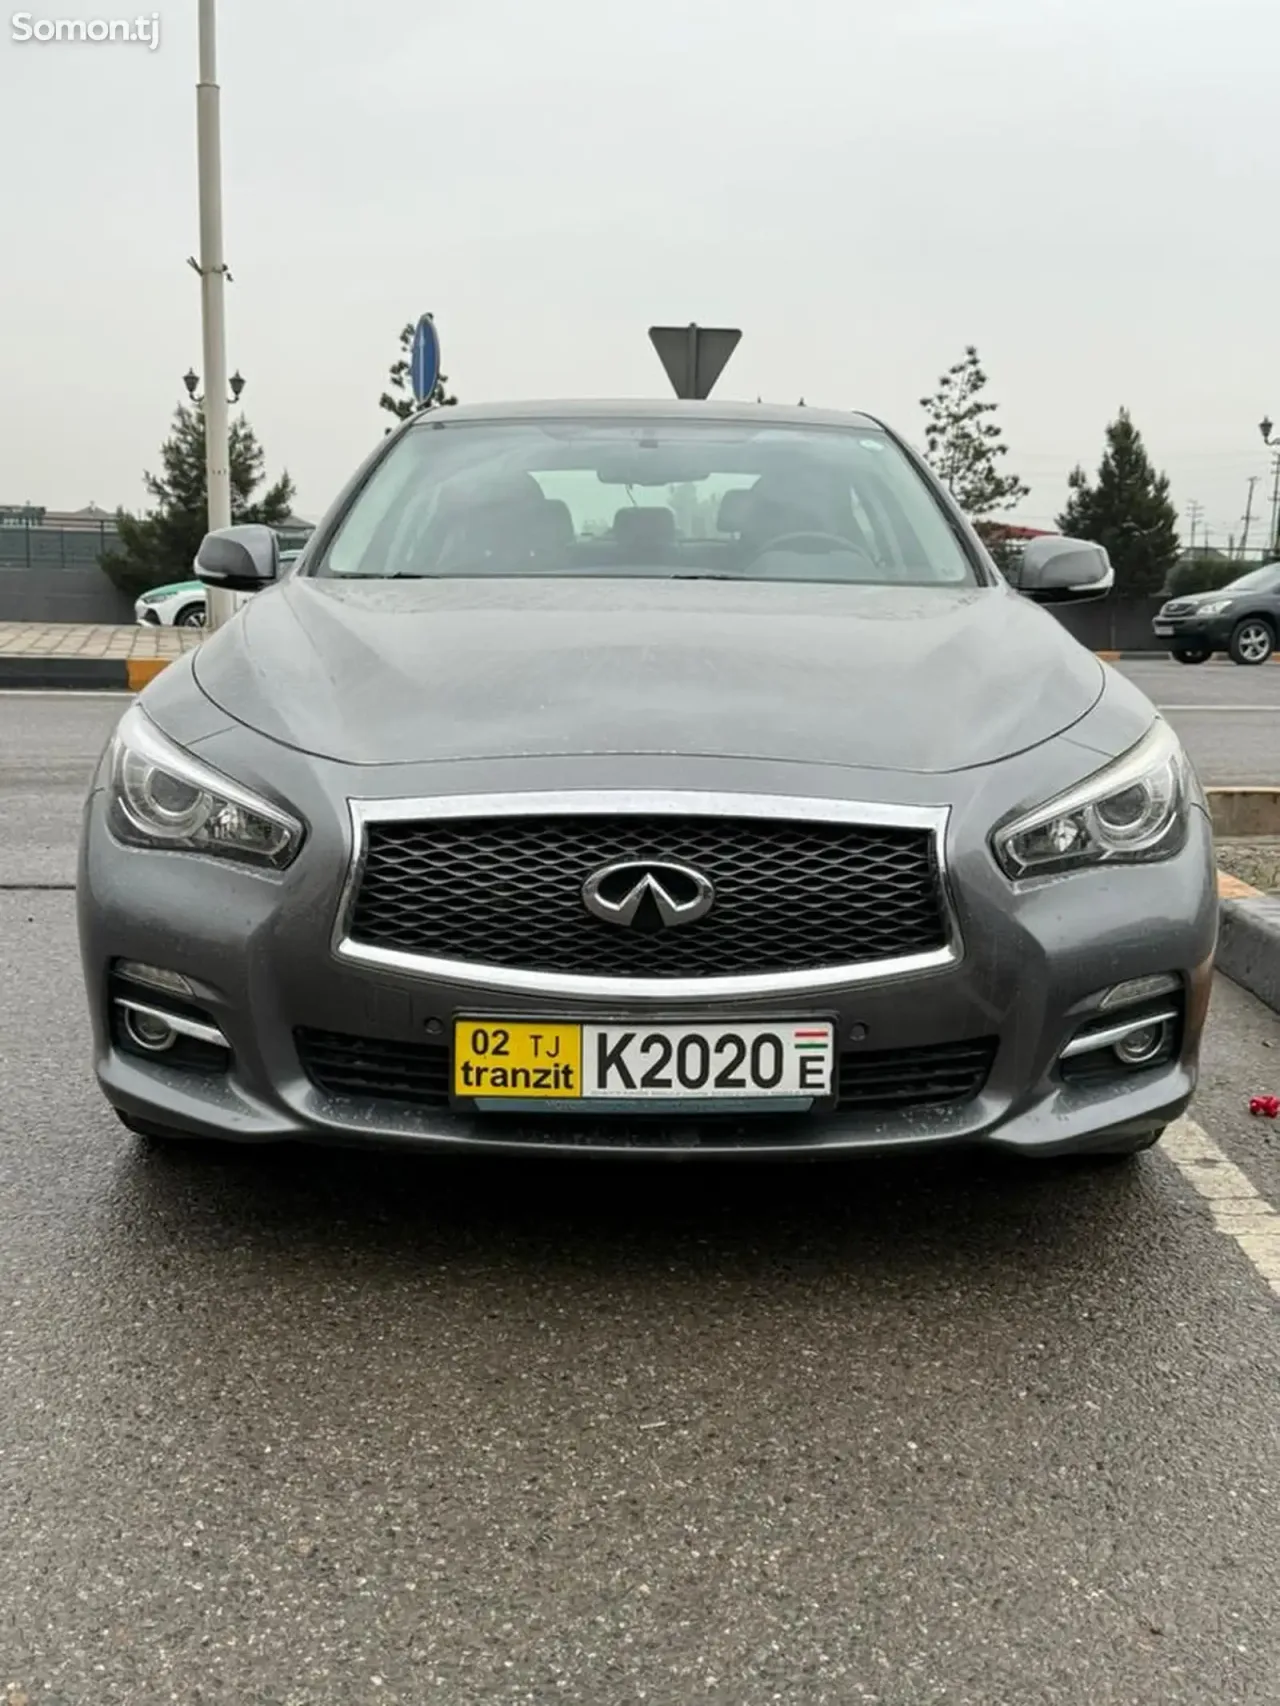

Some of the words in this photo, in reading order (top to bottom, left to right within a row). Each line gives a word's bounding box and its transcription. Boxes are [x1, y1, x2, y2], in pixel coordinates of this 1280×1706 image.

[471, 1029, 510, 1056] 02
[530, 1034, 560, 1058] TJ
[461, 1061, 574, 1090] tranzit
[597, 1033, 784, 1090] K2020
[799, 1056, 825, 1089] E
